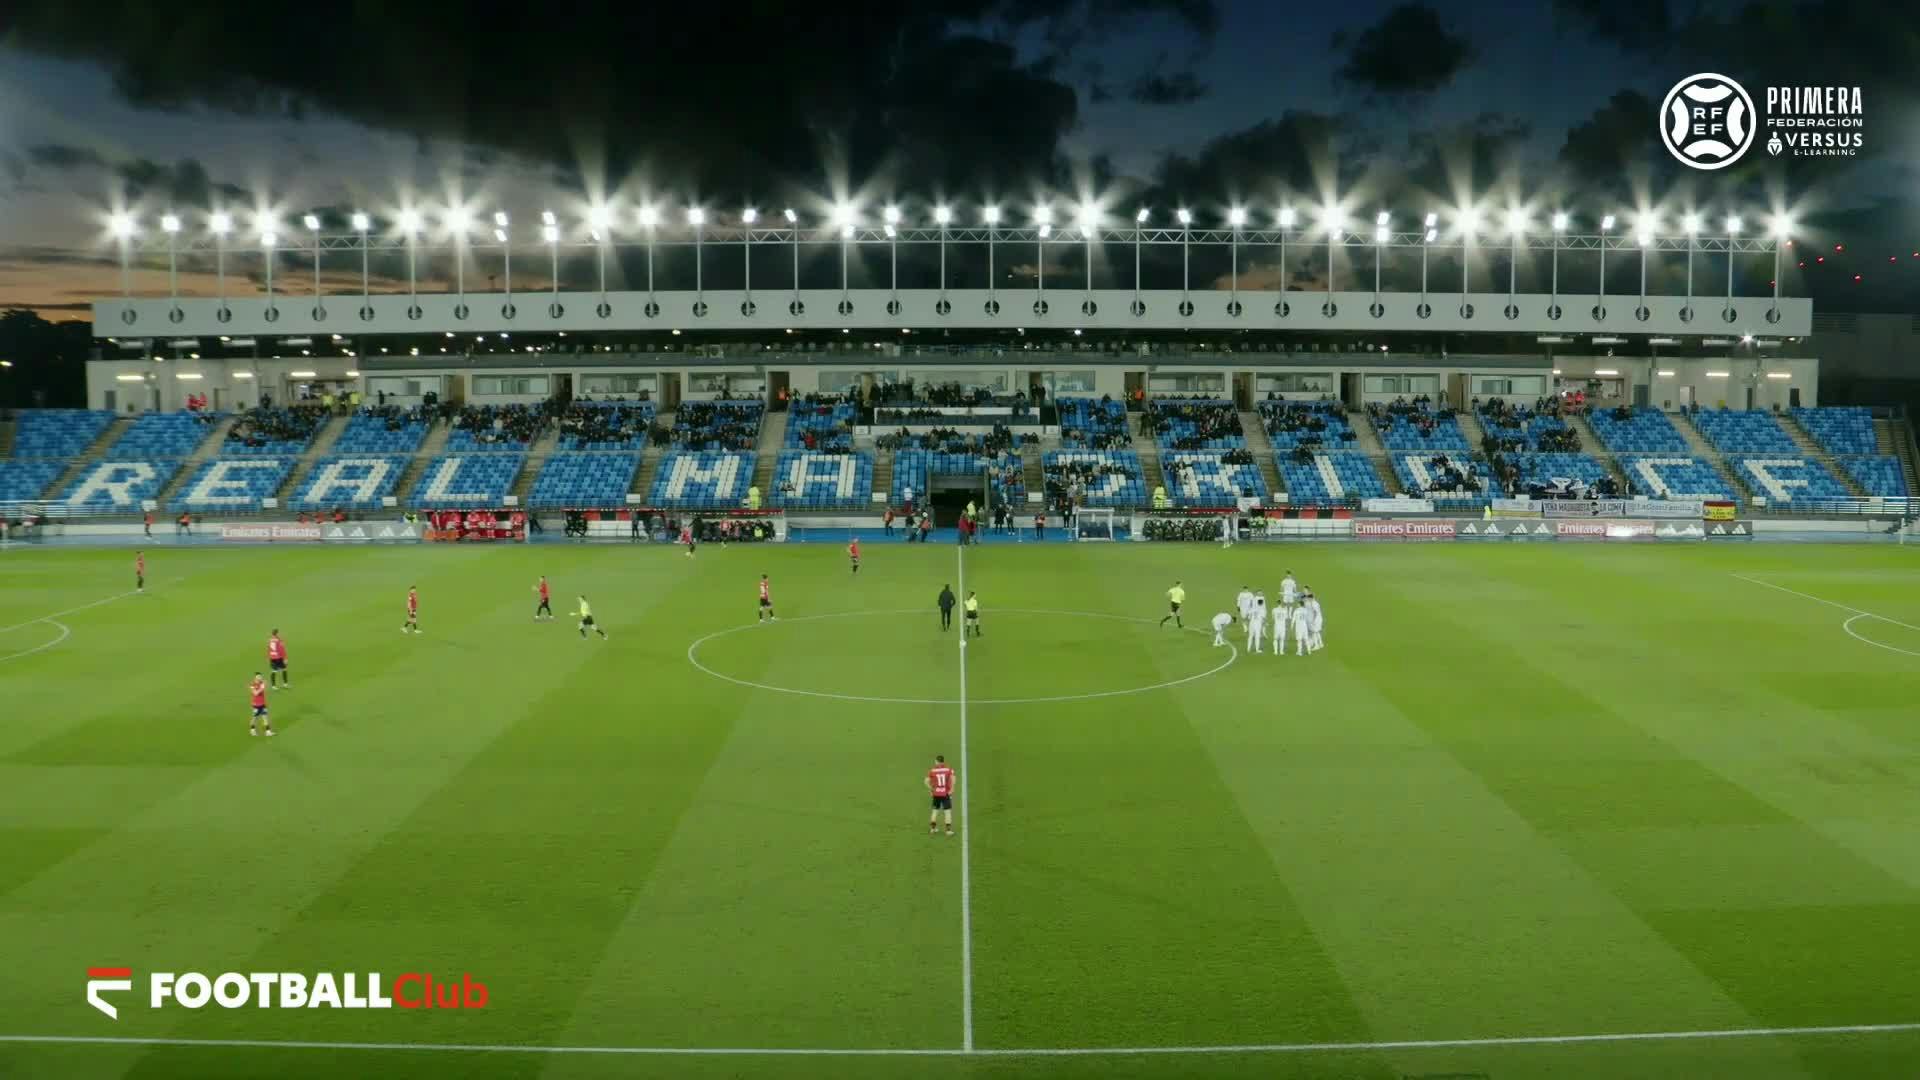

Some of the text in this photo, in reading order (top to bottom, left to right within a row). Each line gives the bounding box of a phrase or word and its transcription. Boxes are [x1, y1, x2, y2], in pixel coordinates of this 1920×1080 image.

[67, 457, 489, 506] REAL
[1355, 522, 1455, 534] Emirates Emirates
[1558, 522, 1605, 535] Emirates
[935, 773, 946, 787] 11
